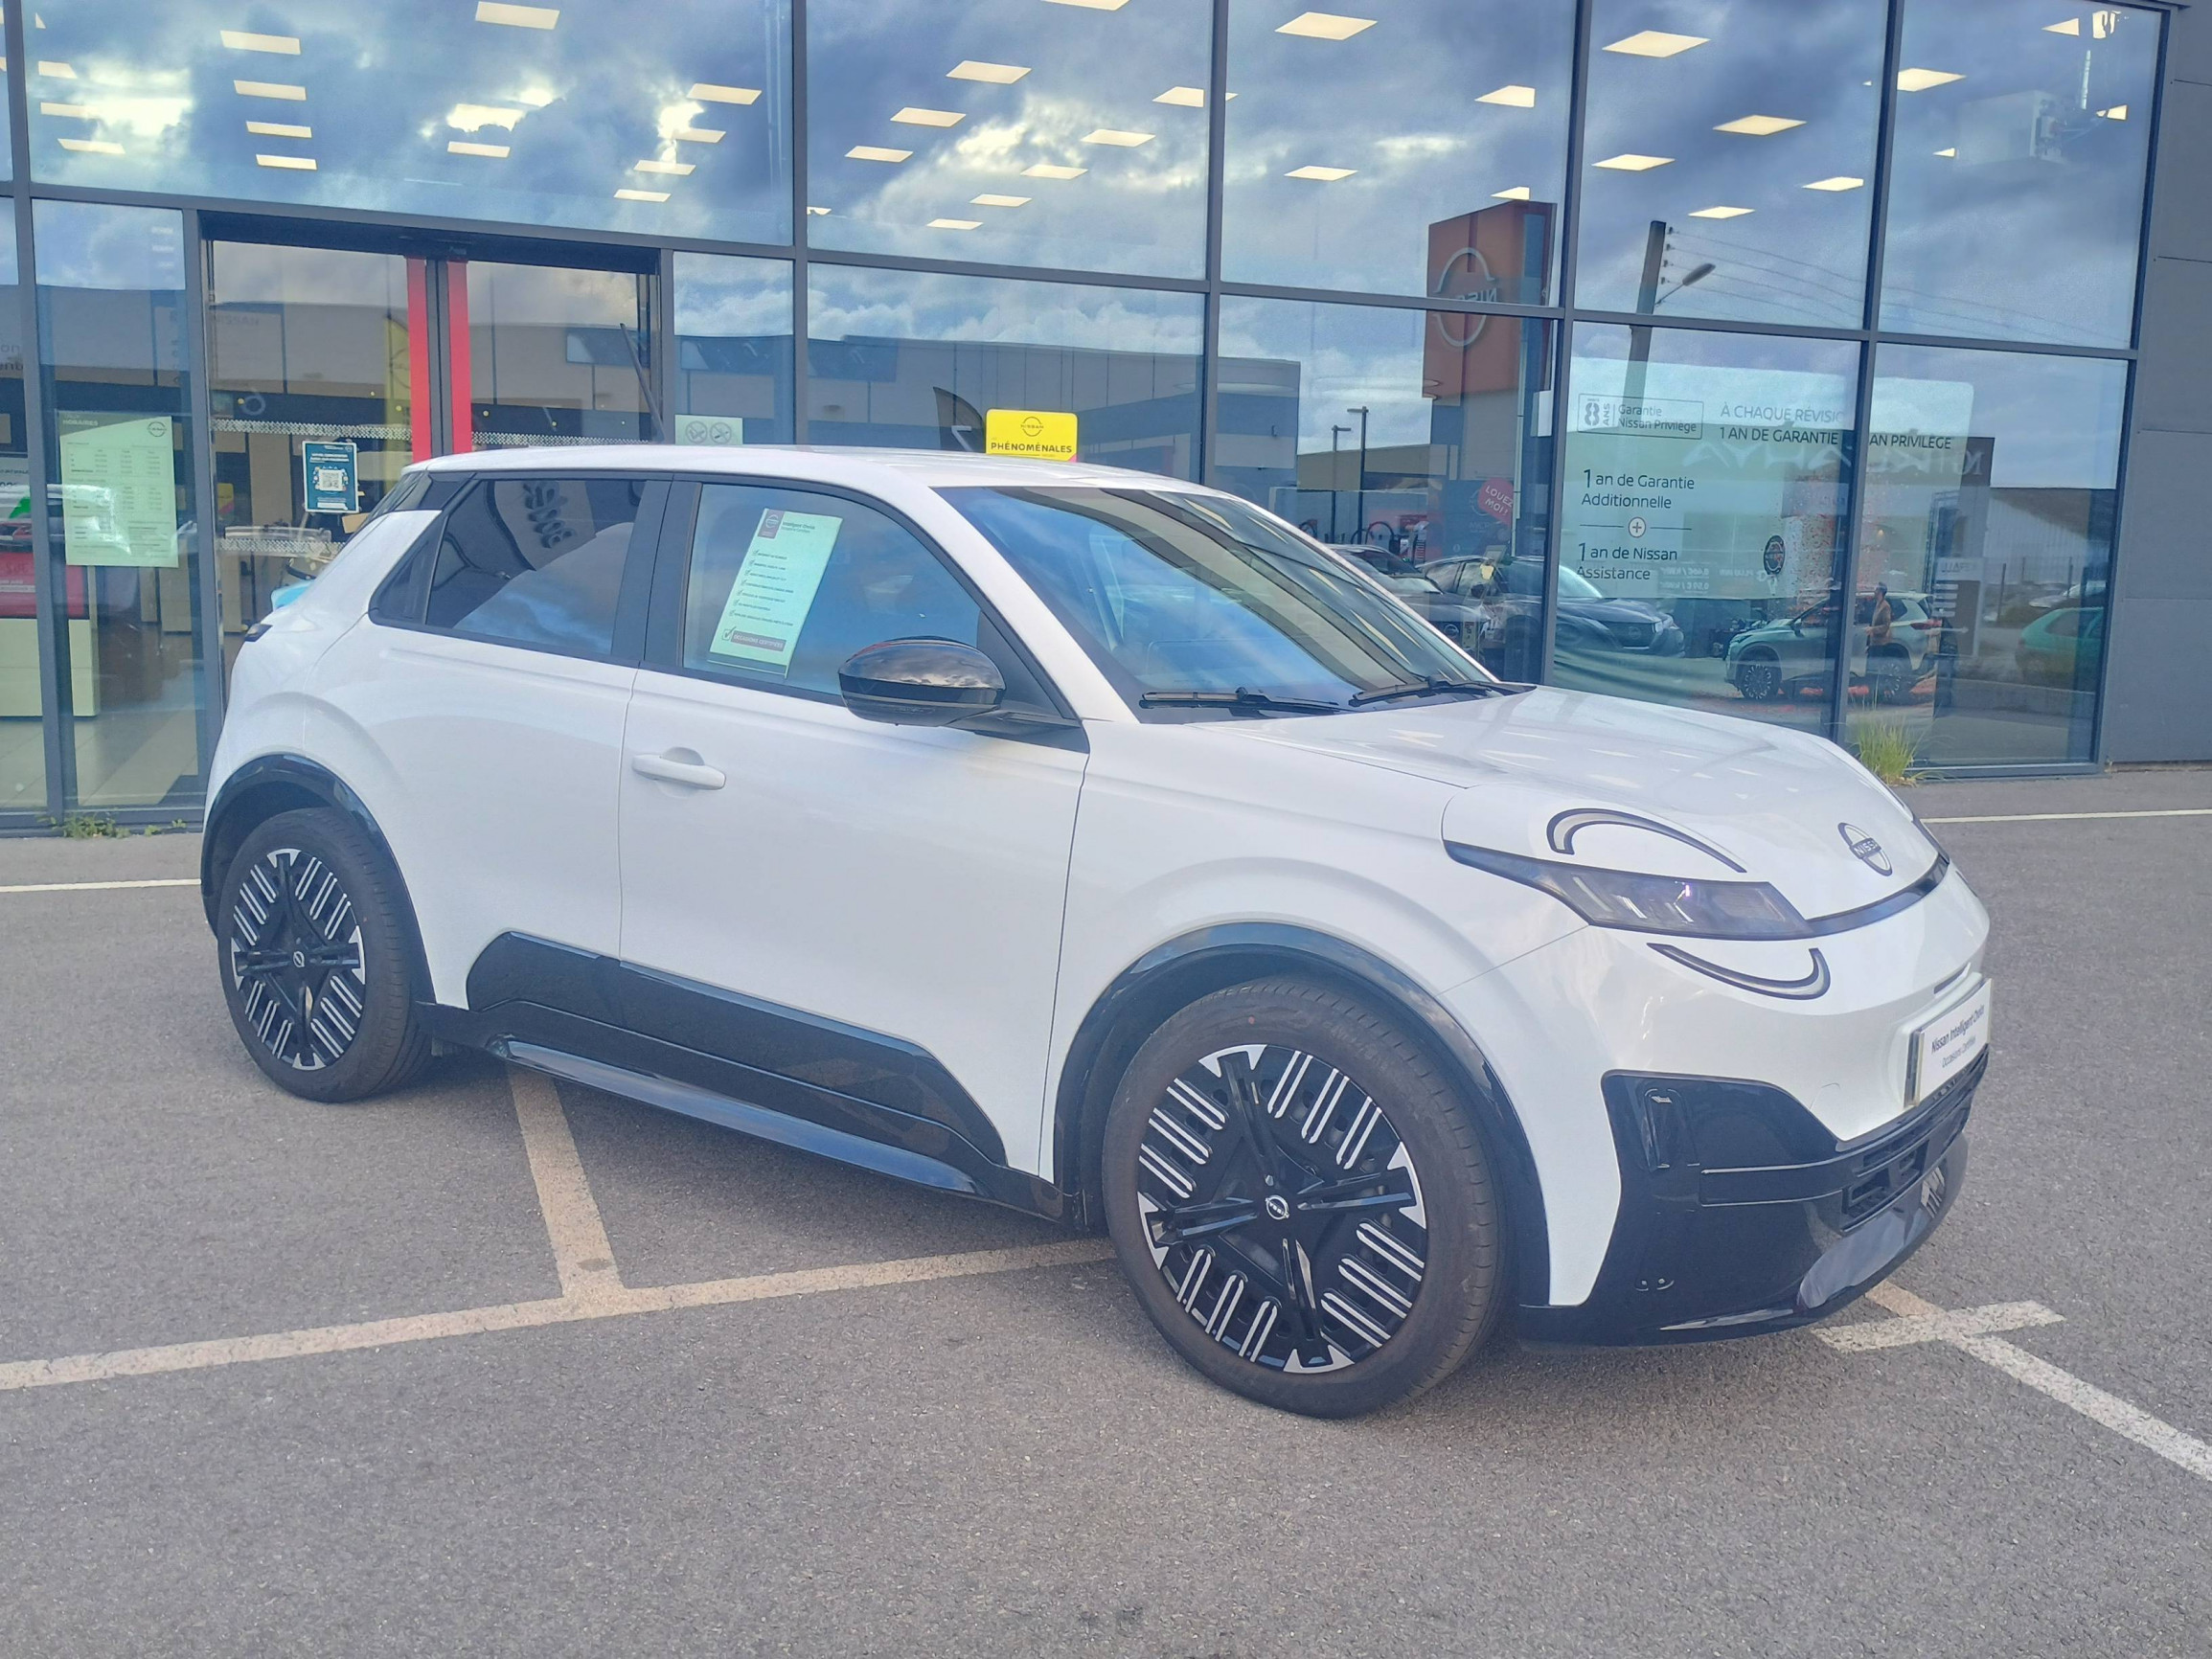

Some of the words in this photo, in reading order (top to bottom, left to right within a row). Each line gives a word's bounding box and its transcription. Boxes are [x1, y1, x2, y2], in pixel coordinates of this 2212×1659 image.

[1619, 404, 1662, 417] Garantie
[1734, 405, 1791, 421] CHAQUE
[1619, 418, 1652, 429] Nissan
[1728, 427, 1747, 440] AN
[1752, 428, 1769, 441] DE
[1772, 429, 1838, 444] GARANTIE
[991, 441, 1072, 453] PHÉNOMÉNALES
[1584, 468, 1590, 489] 1
[1596, 474, 1613, 486] an
[1617, 474, 1634, 487] de
[1637, 474, 1695, 489] Garantie
[1485, 486, 1514, 508] LOUEZ
[1582, 493, 1672, 509] Additionnelle
[1579, 542, 1585, 561] 1
[1590, 548, 1608, 558] an
[1612, 547, 1630, 559] de
[1633, 548, 1677, 560] Nissan
[1577, 566, 1651, 580] Assistance
